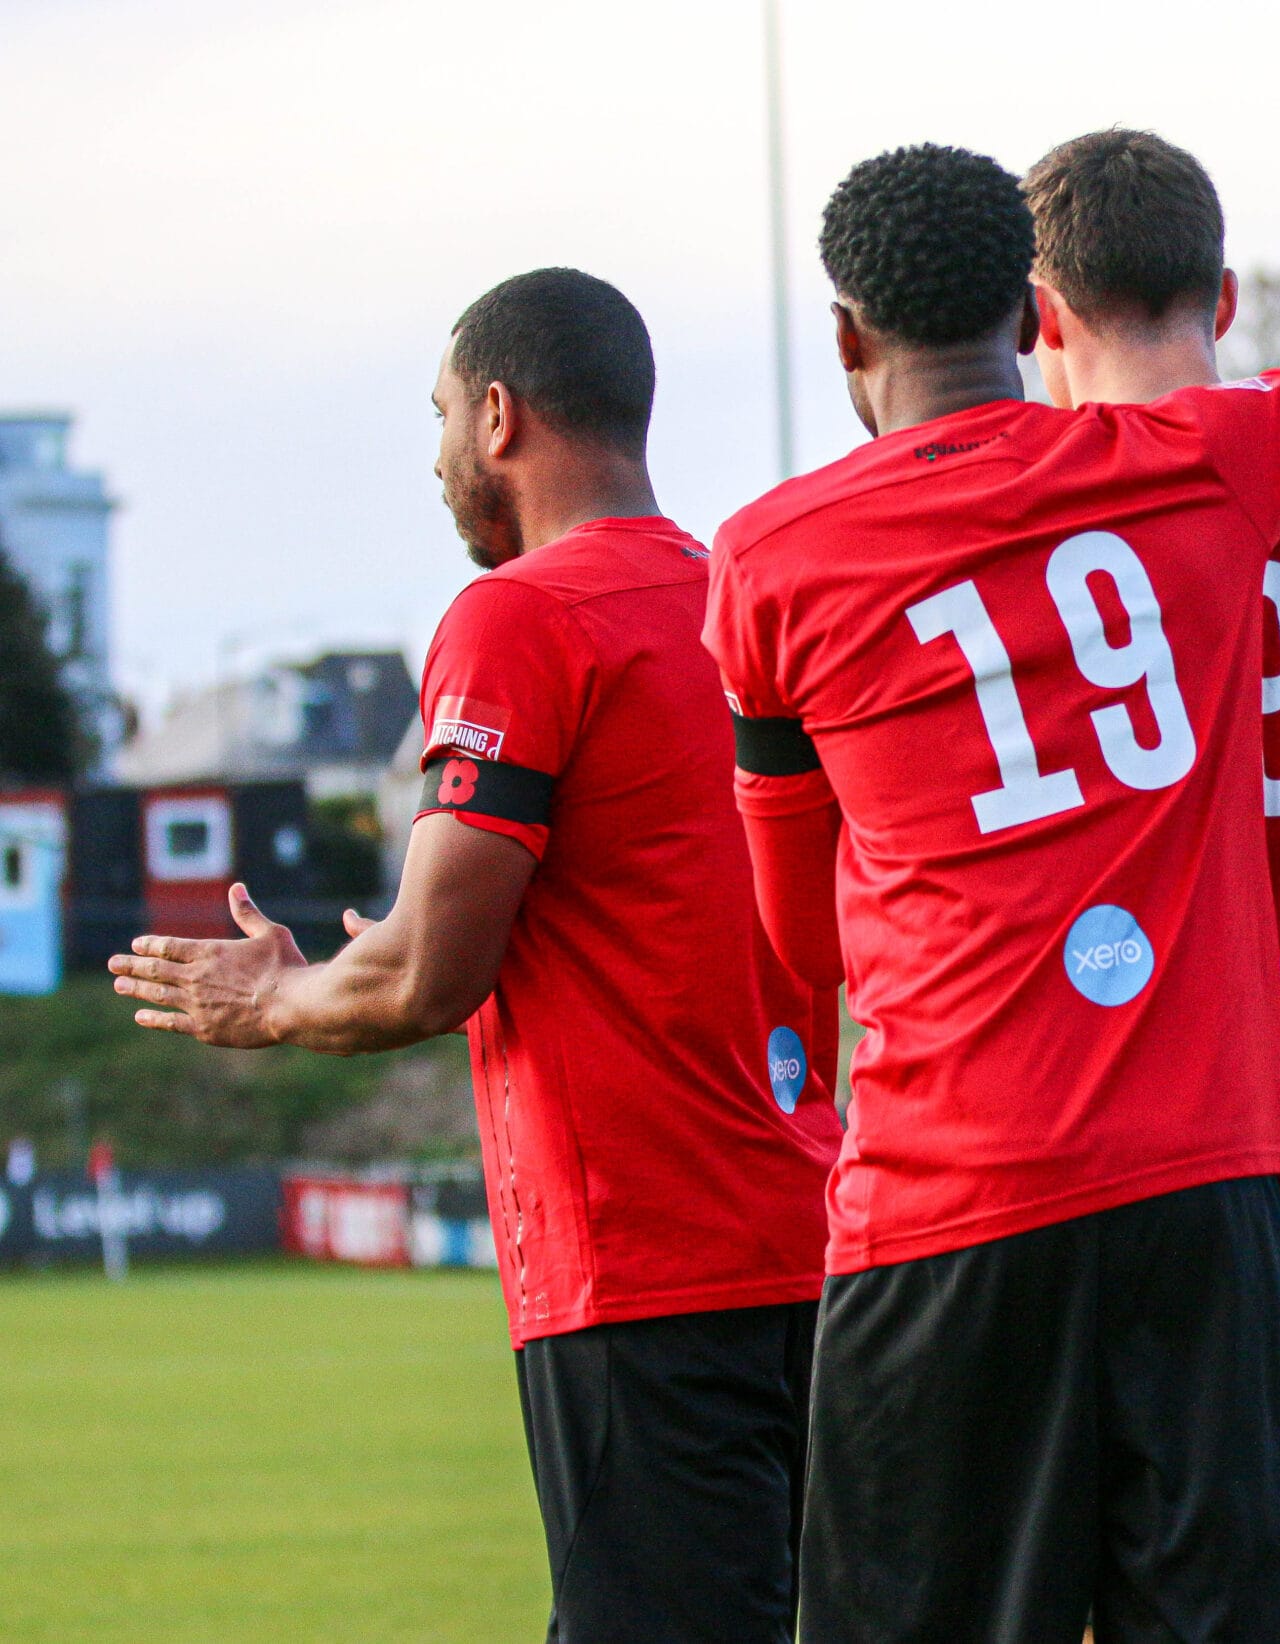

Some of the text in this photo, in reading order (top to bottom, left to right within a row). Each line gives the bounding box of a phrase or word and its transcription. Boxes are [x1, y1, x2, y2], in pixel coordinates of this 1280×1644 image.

[904, 530, 1197, 835] 19
[1072, 939, 1142, 975] xero
[769, 1057, 800, 1083] xero
